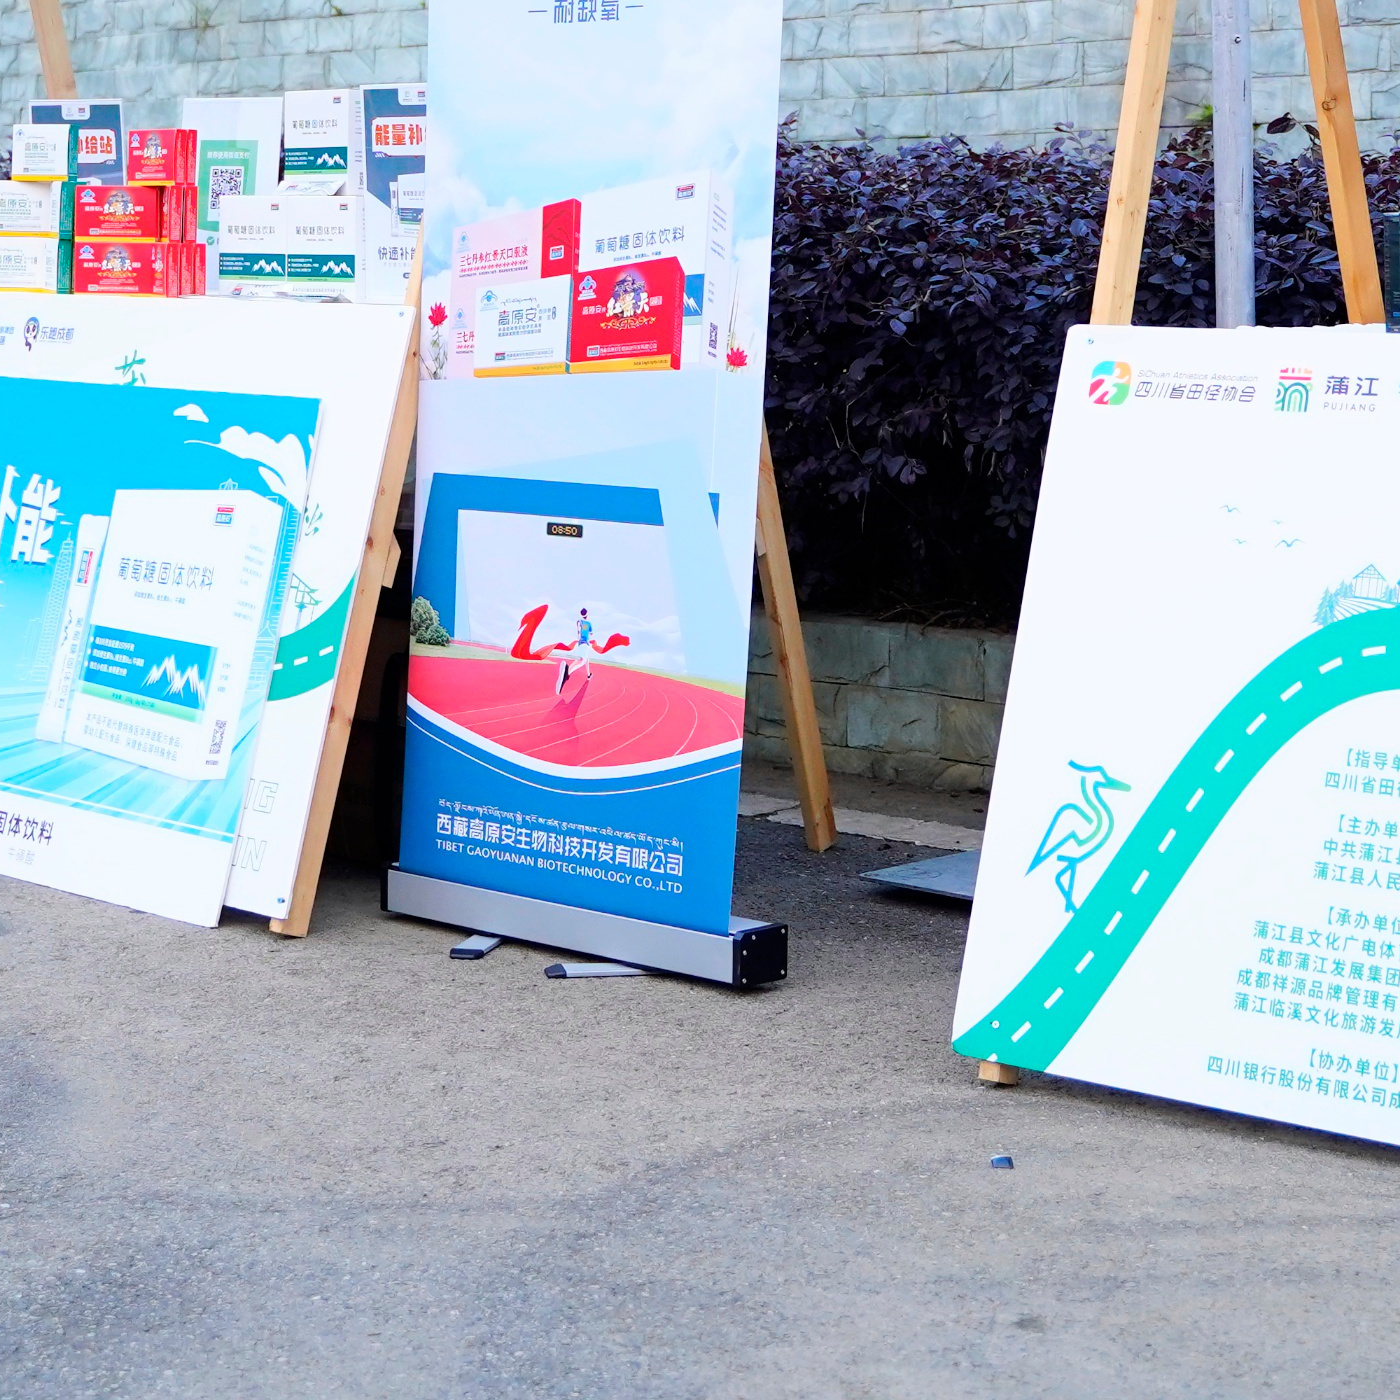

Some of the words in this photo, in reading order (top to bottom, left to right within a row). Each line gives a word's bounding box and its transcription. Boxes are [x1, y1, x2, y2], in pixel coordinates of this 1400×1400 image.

[78, 134, 113, 155] 给站
[595, 226, 685, 254] 葡萄糖固体饮料
[39, 327, 74, 340] 乐跑成都
[1134, 381, 1256, 403] 四川省田径协会
[1324, 375, 1380, 397] 蒲江
[1323, 402, 1376, 412] PUJIANG
[118, 557, 215, 591] 葡萄糖固体饮料
[437, 813, 683, 877] 西藏高原安生物科技开发有限公司
[436, 839, 465, 853] TIBET
[466, 845, 535, 866] GAOYUANAN
[537, 858, 632, 884] BIOTECHNOLOGY
